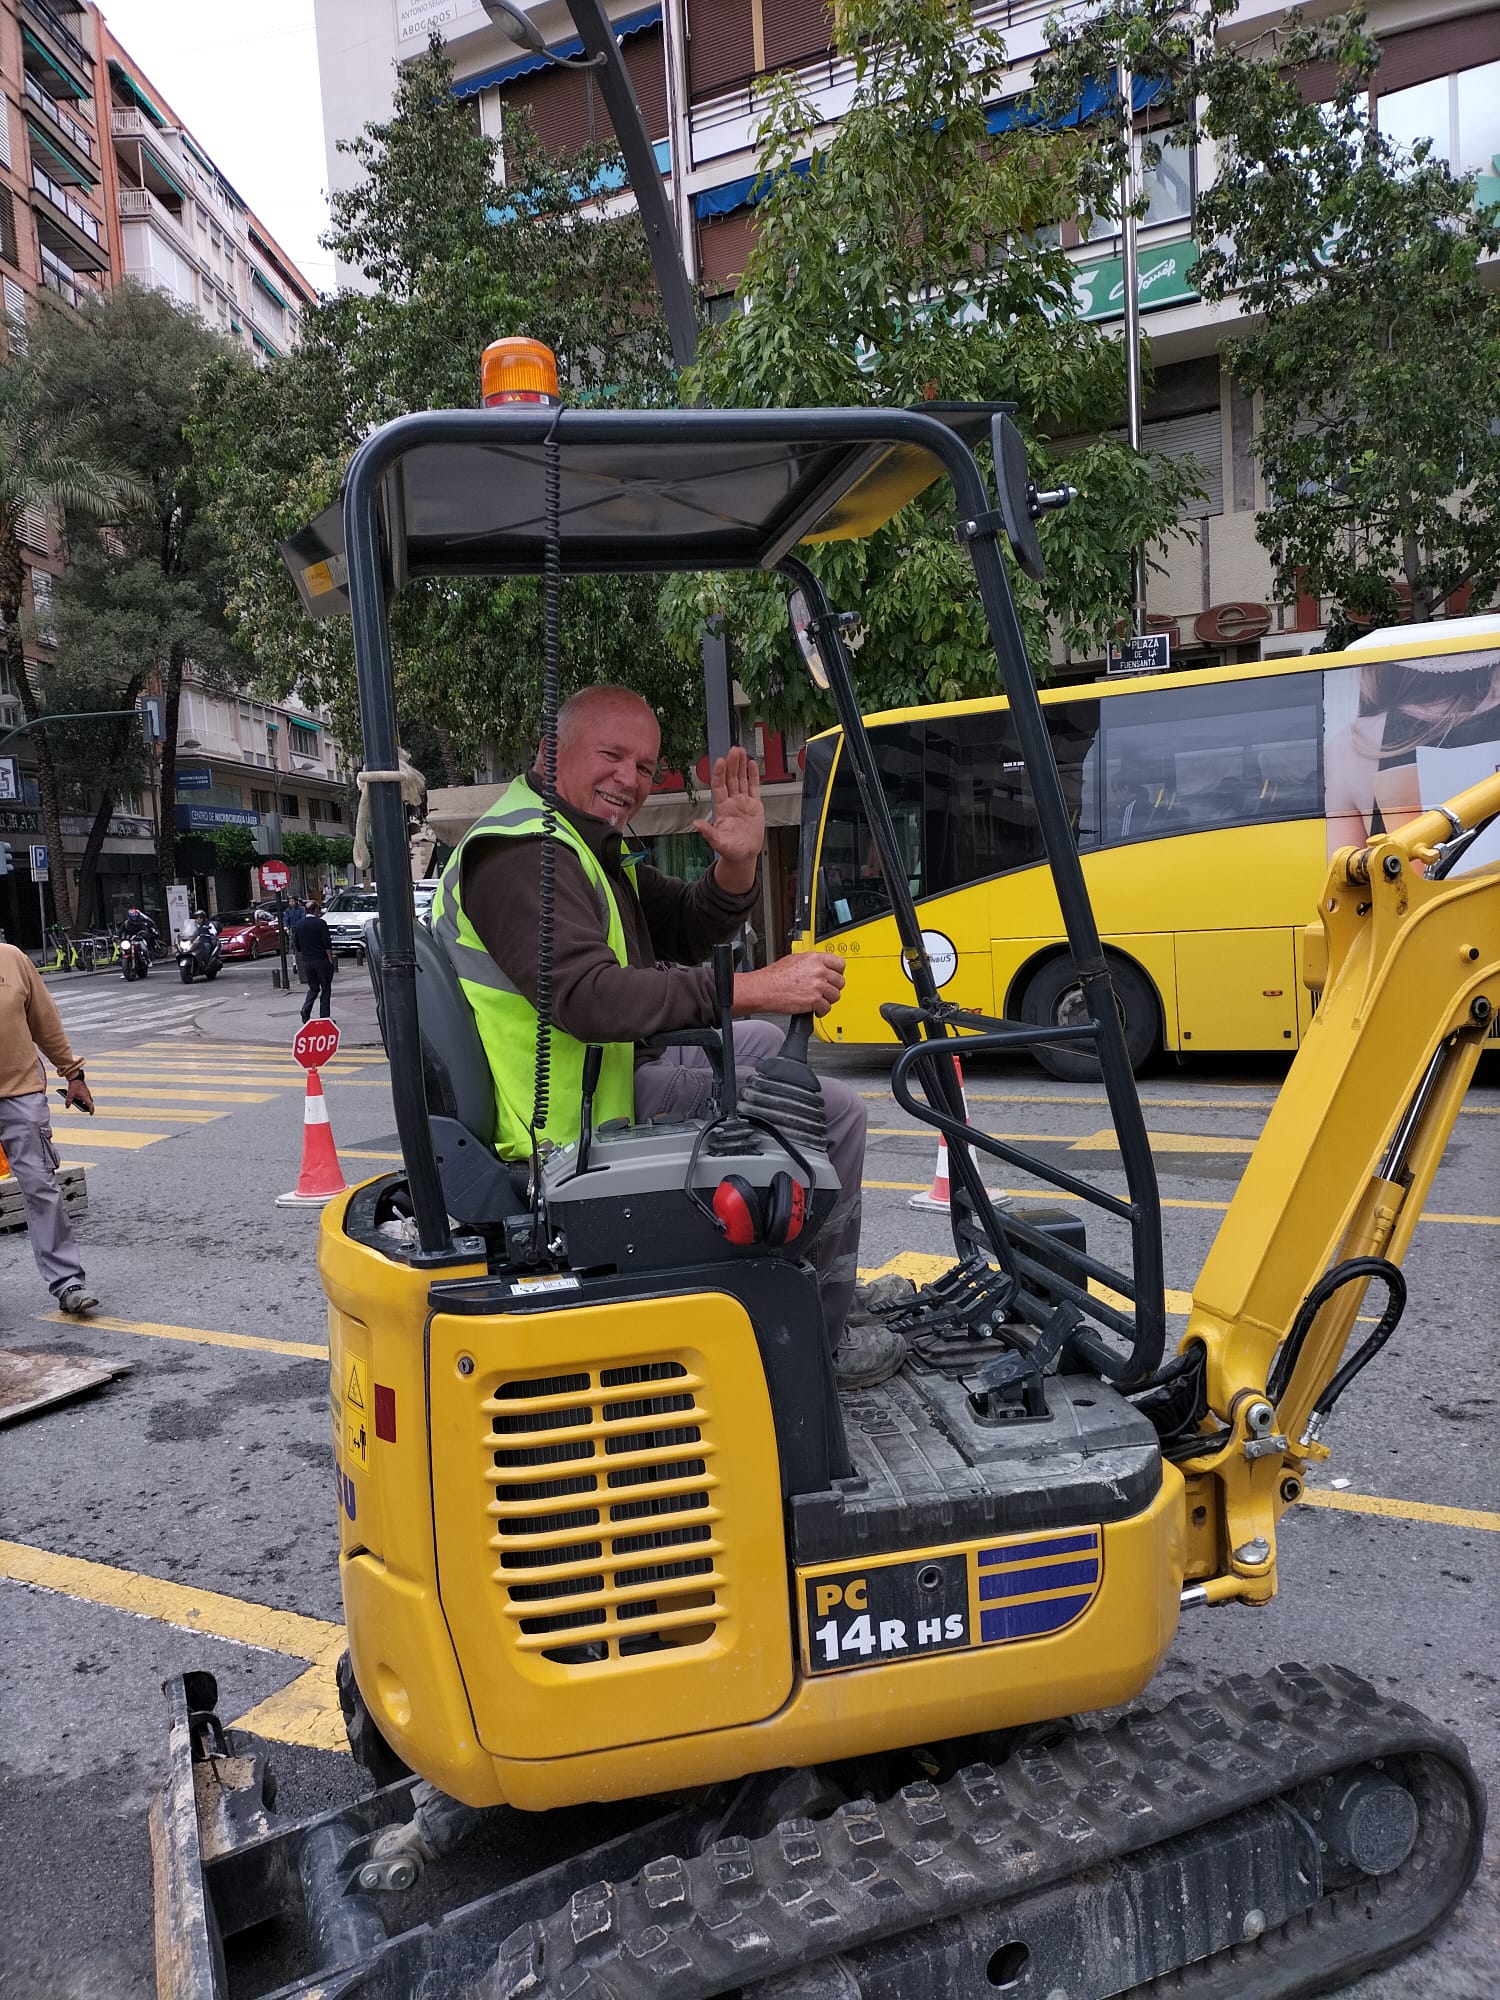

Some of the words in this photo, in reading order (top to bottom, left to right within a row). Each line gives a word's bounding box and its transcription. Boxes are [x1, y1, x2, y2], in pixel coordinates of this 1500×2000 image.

[403, 10, 451, 37] ABOGADOS
[1131, 638, 1159, 650] PLAZA
[1134, 650, 1143, 659] DE
[1148, 649, 1157, 658] LA
[1120, 659, 1156, 669] FUENSANTA
[36, 848, 44, 867] P
[296, 1034, 336, 1054] STOP
[816, 1579, 868, 1617] PC
[815, 1614, 909, 1662] 14R
[917, 1613, 965, 1646] HS
